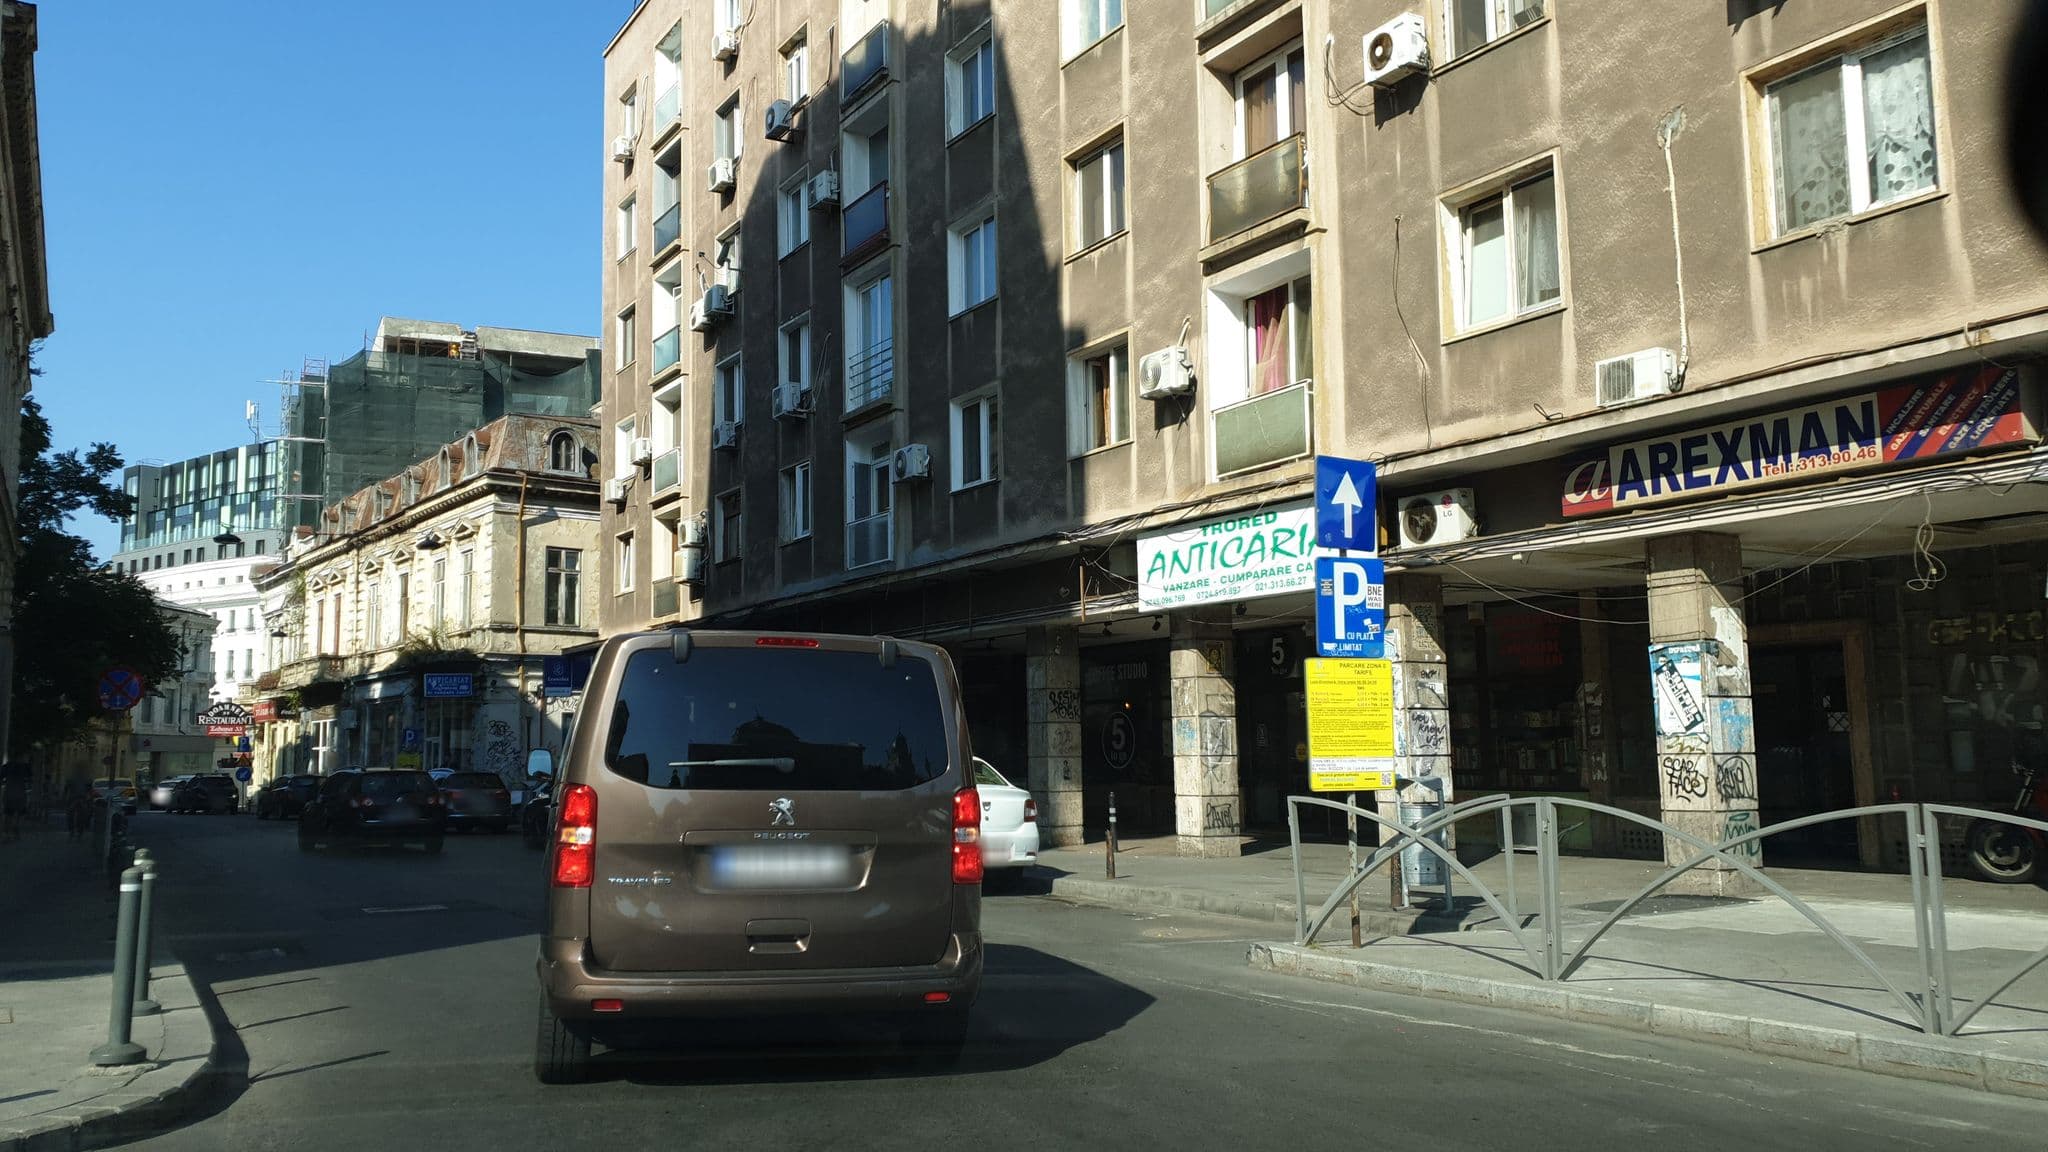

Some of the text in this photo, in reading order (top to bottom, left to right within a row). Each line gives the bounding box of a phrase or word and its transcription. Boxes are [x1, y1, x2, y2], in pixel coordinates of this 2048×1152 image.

[1908, 381, 1949, 427] NATURALE
[1615, 400, 1877, 502] AREXMAN
[1201, 511, 1278, 537] TRORED
[1443, 510, 1453, 518] LG
[1162, 579, 1211, 593] VANZARE
[1219, 565, 1292, 585] CUMPARARE
[1296, 563, 1313, 573] CA
[1367, 586, 1382, 596] BNE
[1333, 562, 1368, 640] P
[1346, 632, 1355, 640] CU
[1272, 637, 1285, 665] 5
[1120, 661, 1148, 681] STUDIO
[198, 714, 254, 725] RESTAURANT
[1112, 719, 1126, 750] 5
[753, 832, 811, 840] PEUGEOT
